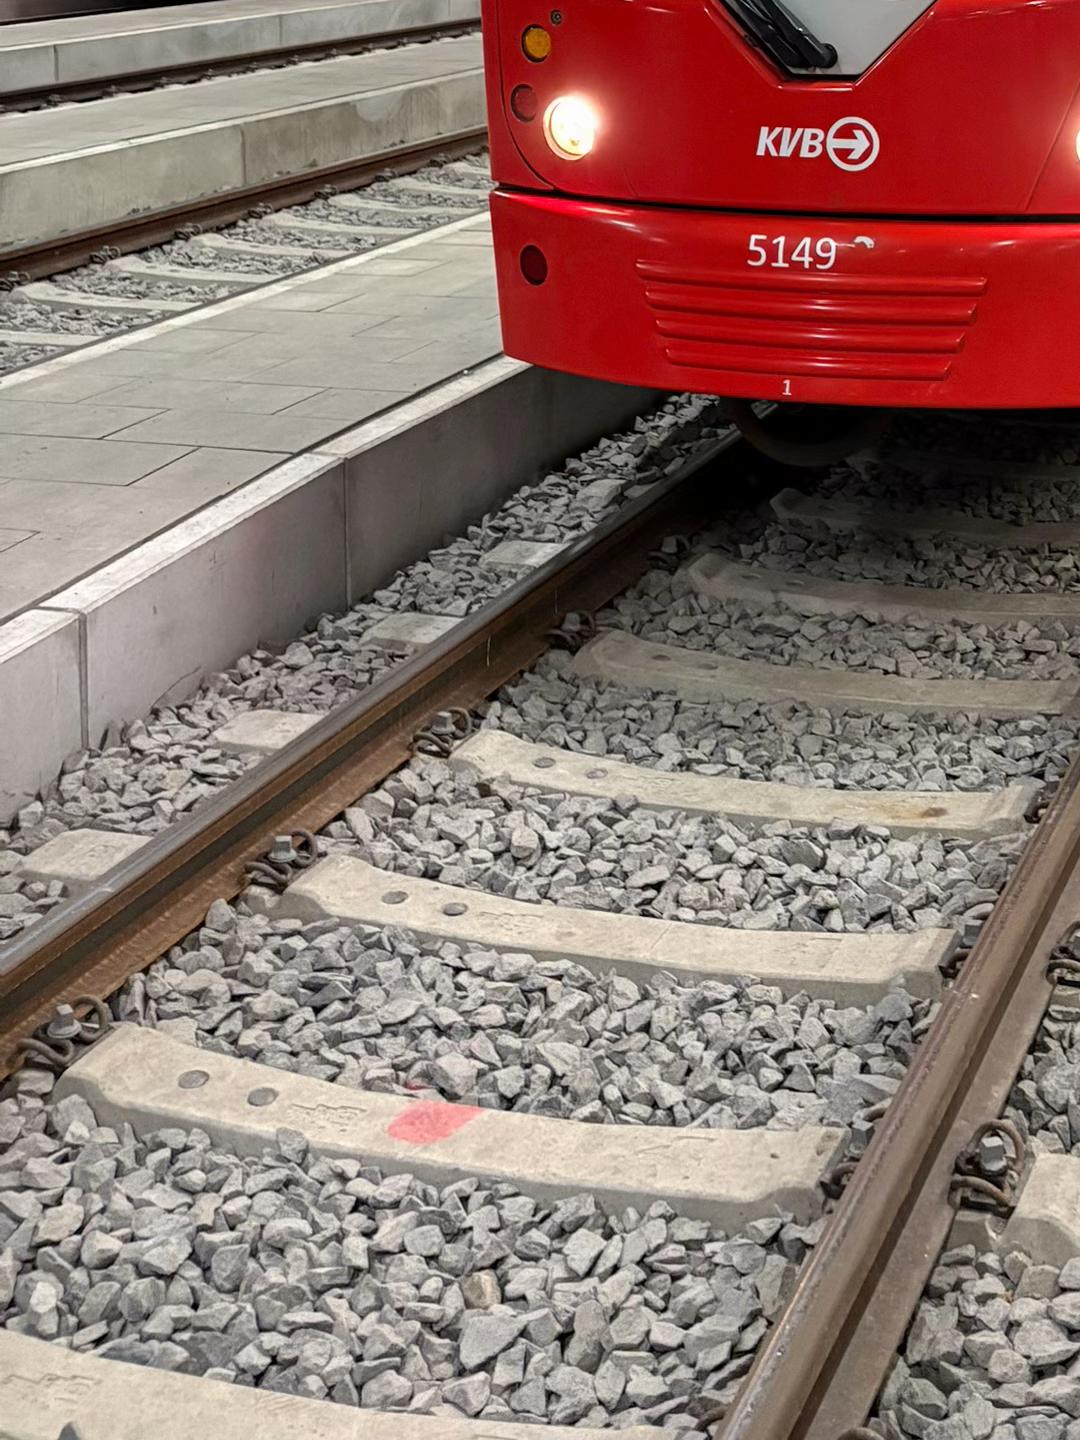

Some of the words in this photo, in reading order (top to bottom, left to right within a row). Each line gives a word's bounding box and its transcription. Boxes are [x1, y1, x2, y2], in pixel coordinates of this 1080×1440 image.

[755, 125, 825, 159] KVB
[746, 233, 837, 271] 5149
[781, 379, 793, 396] 1
